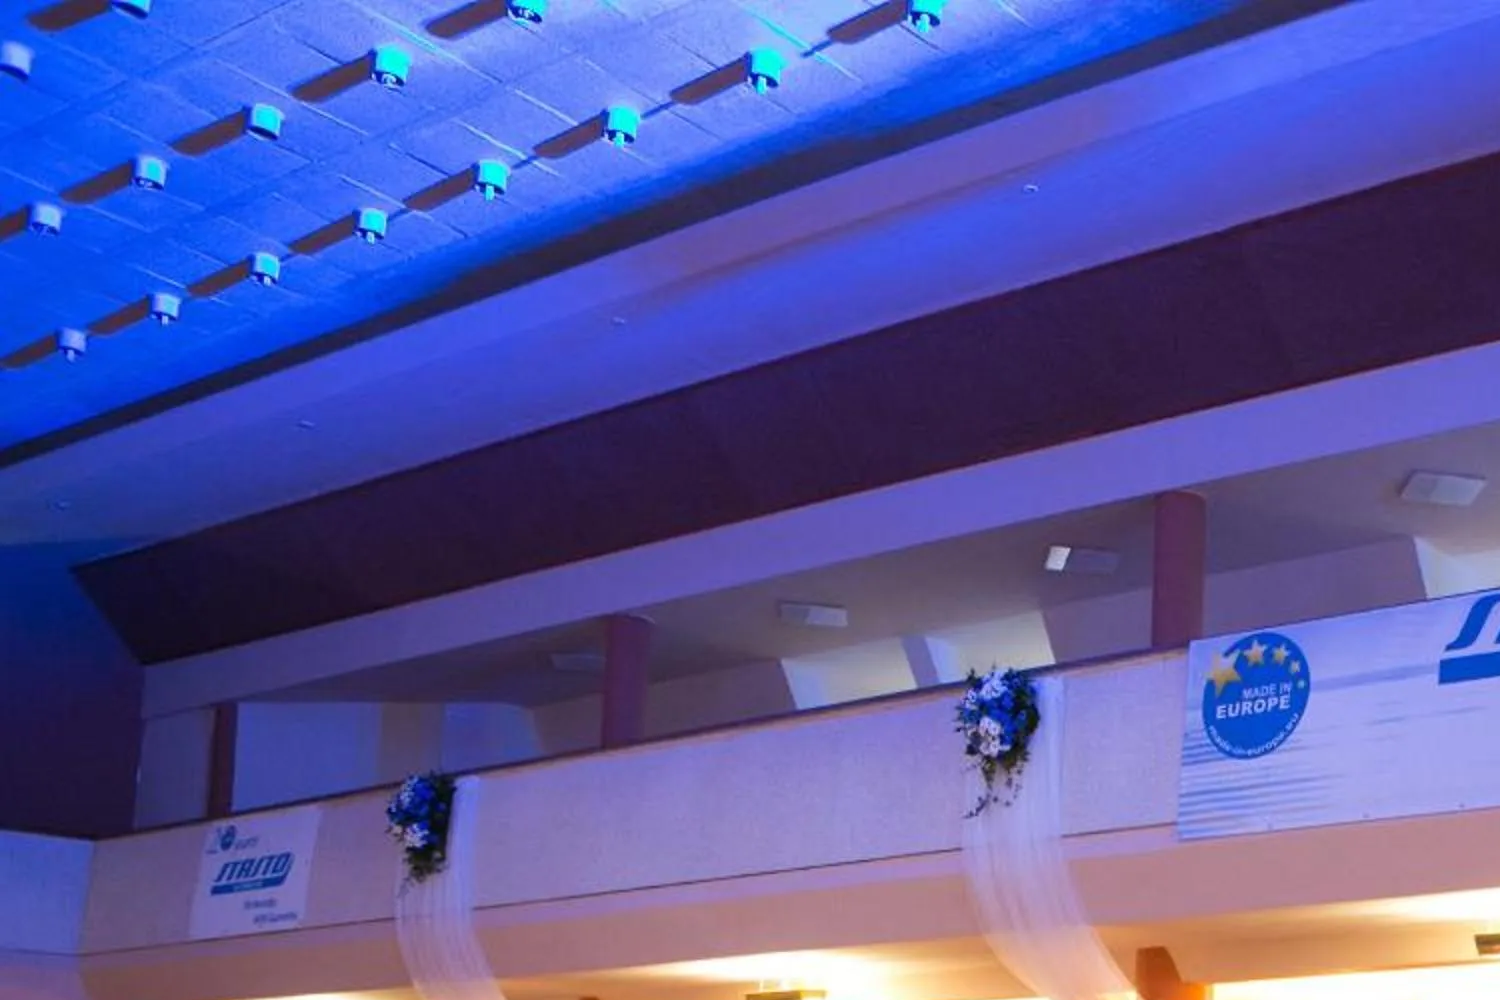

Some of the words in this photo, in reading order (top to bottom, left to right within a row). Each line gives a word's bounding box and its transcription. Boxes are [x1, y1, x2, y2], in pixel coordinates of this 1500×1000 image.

[1242, 682, 1277, 699] MADE
[1279, 680, 1292, 695] IN
[1215, 695, 1291, 719] EUROPE
